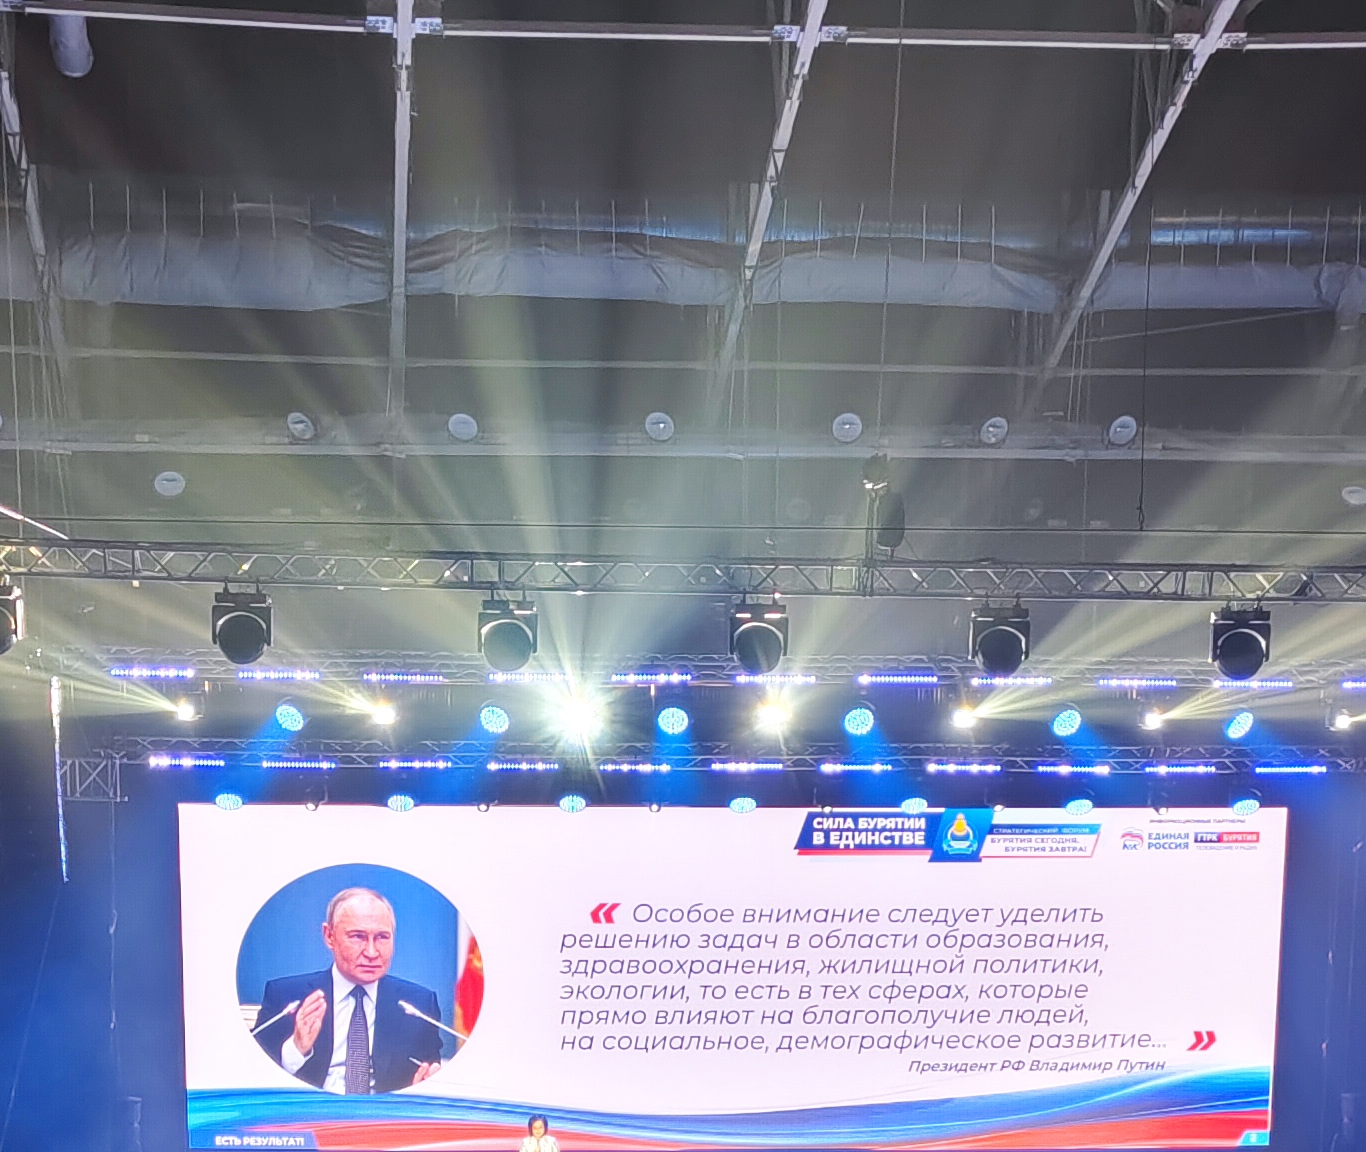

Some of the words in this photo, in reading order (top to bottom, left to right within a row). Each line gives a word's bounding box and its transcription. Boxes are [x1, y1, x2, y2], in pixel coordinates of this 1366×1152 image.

[813, 816, 854, 831] СИЛА
[859, 816, 926, 831] БУРЯТИИ
[813, 833, 824, 847] В
[829, 832, 925, 848] ЕДИНСТВЕ
[1148, 832, 1189, 840] ЕДИНАЯ
[1148, 842, 1189, 850] РОССИЯ
[633, 903, 735, 923] Особое
[742, 906, 880, 923] внимание
[888, 907, 993, 928] следует
[996, 906, 1104, 927] уделить
[560, 933, 690, 952] решению
[698, 934, 778, 951] задач
[787, 934, 800, 948] в
[808, 929, 917, 949] области
[926, 929, 1110, 951] образования,
[560, 958, 810, 979] здравоохранения,
[818, 953, 965, 976] жилищной
[973, 959, 1104, 977] политики,
[560, 984, 690, 1003] экологии,
[699, 985, 726, 999] то
[735, 985, 789, 1000] есть
[799, 985, 811, 999] в
[821, 984, 860, 1000] тех
[868, 979, 969, 1003] сферах,
[978, 983, 1089, 1002] которые
[561, 1009, 646, 1029] прямо
[655, 1009, 754, 1025] влияют
[761, 1009, 793, 1025] на
[802, 1005, 991, 1028] благополучие
[996, 1004, 1089, 1026] людей,
[561, 1036, 594, 1051] на
[602, 1035, 769, 1054] социальное,
[775, 1030, 1021, 1054] демографическое
[908, 1061, 997, 1074] Президент
[1000, 1060, 1025, 1072] РФ
[1029, 1058, 1112, 1073] Владимир
[1116, 1058, 1166, 1072] Путин
[215, 1136, 241, 1146] ЕСТЬ
